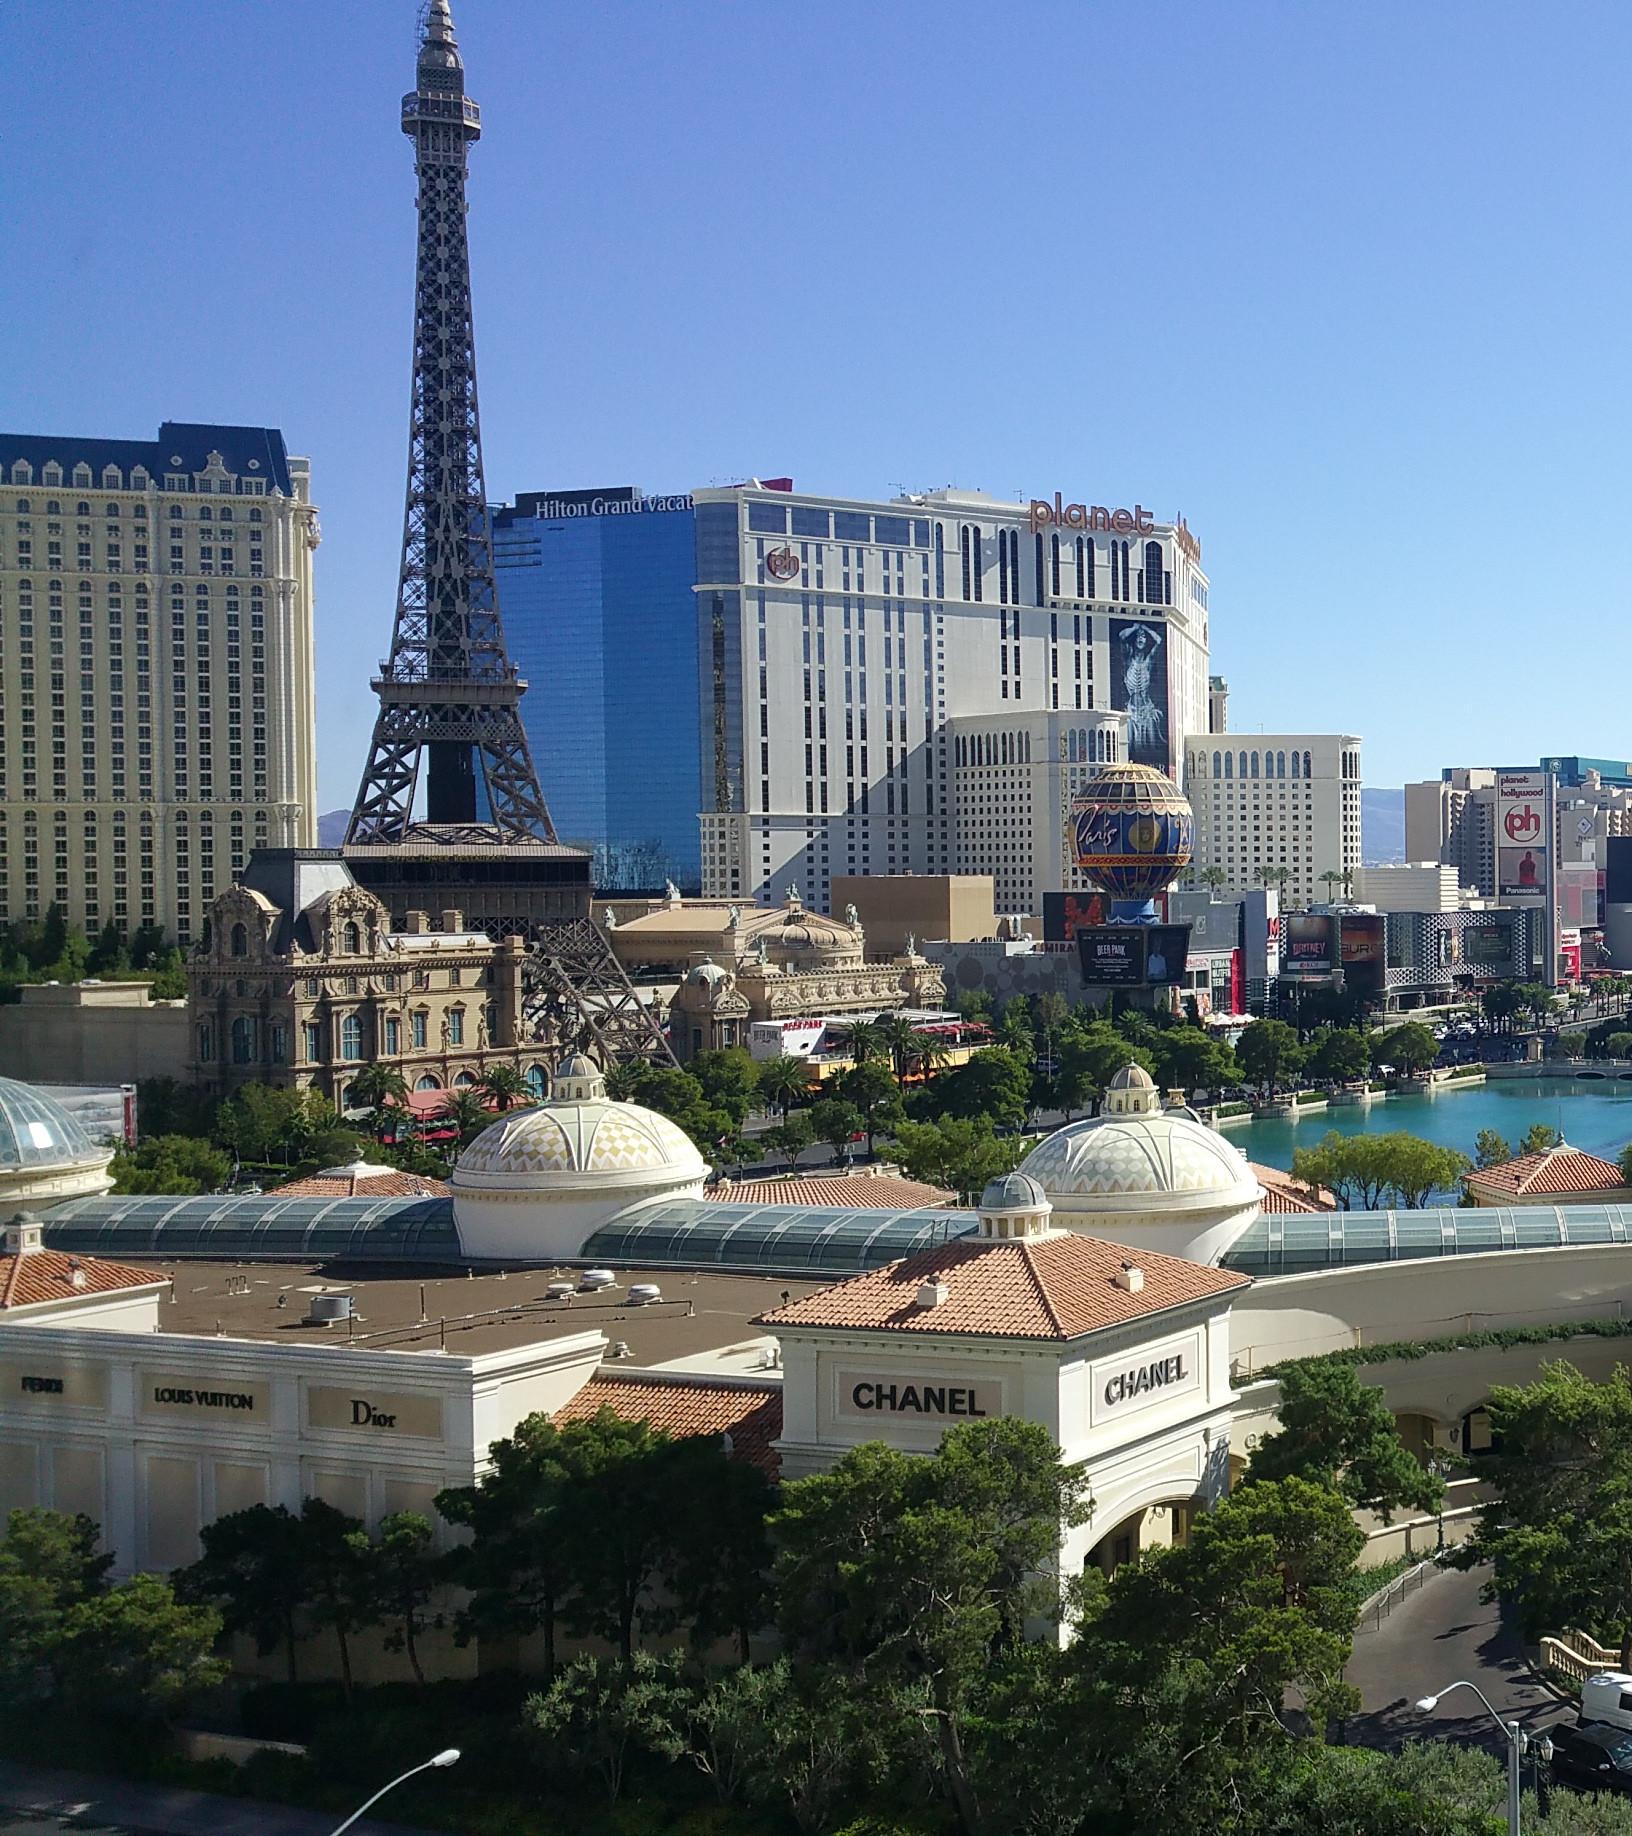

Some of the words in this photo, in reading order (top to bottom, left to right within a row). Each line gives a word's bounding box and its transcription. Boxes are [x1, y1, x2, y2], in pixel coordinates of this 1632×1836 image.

[535, 499, 588, 520] Hilton
[591, 496, 642, 516] Grand
[1030, 491, 1154, 537] planet
[1501, 776, 1529, 786] planet
[1501, 788, 1543, 798] hollywood
[1075, 804, 1118, 859] Paris
[1505, 887, 1540, 895] Panasonic
[1097, 945, 1111, 956] BEER
[1111, 944, 1126, 956] PARK
[1105, 1353, 1189, 1406] CHANEL
[154, 1388, 194, 1404] LOUIS
[195, 1391, 253, 1410] VUITTON
[852, 1382, 986, 1417] CHANEL
[350, 1400, 396, 1428] Dior
